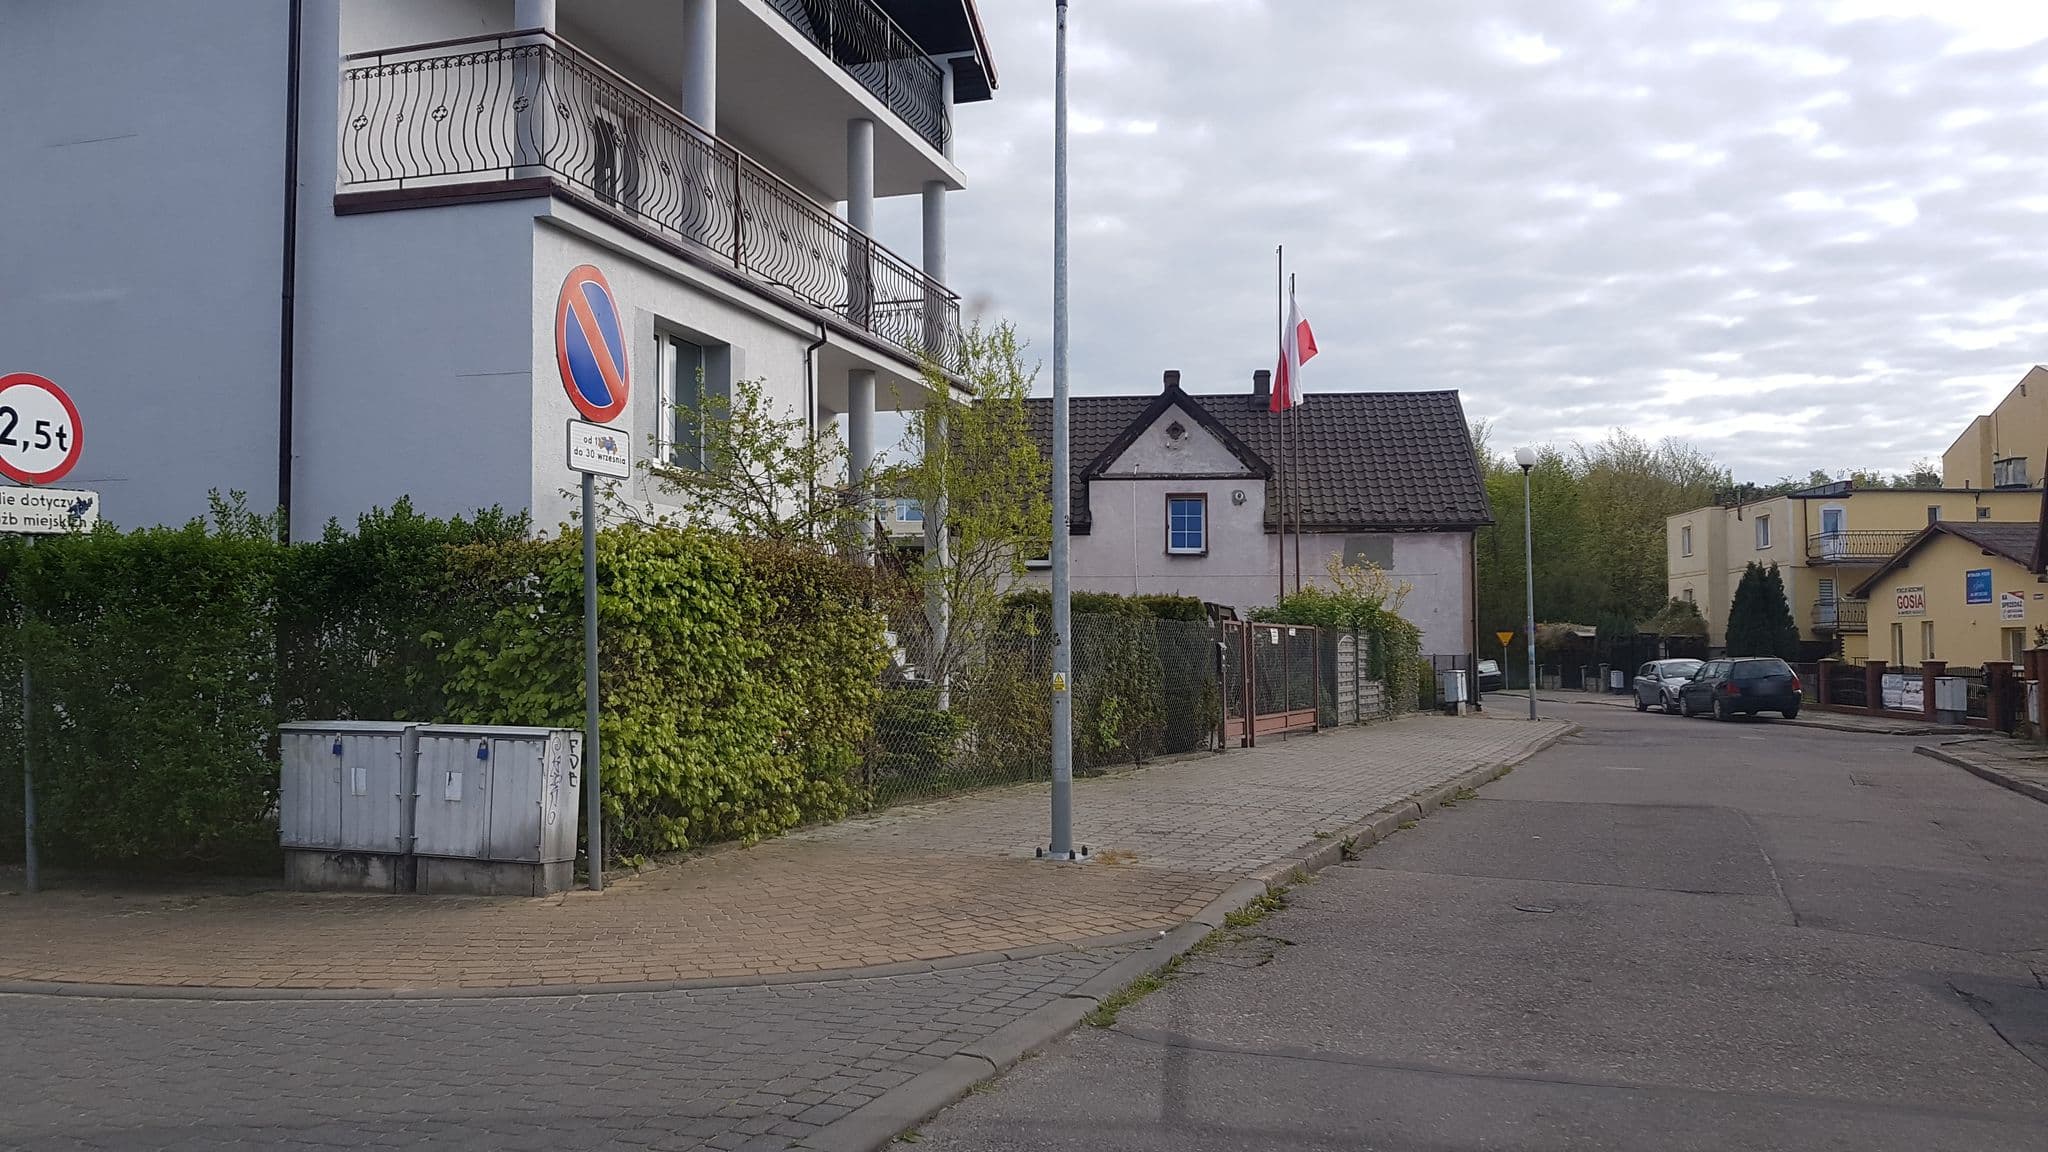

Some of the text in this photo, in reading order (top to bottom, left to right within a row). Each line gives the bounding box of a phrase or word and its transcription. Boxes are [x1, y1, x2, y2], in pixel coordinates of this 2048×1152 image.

[583, 436, 592, 444] od
[574, 447, 583, 456] do
[585, 449, 594, 458] 30
[0, 492, 74, 511] ie dotyczy
[0, 512, 87, 530] żb miejskh
[1896, 594, 1924, 610] GOSIA
